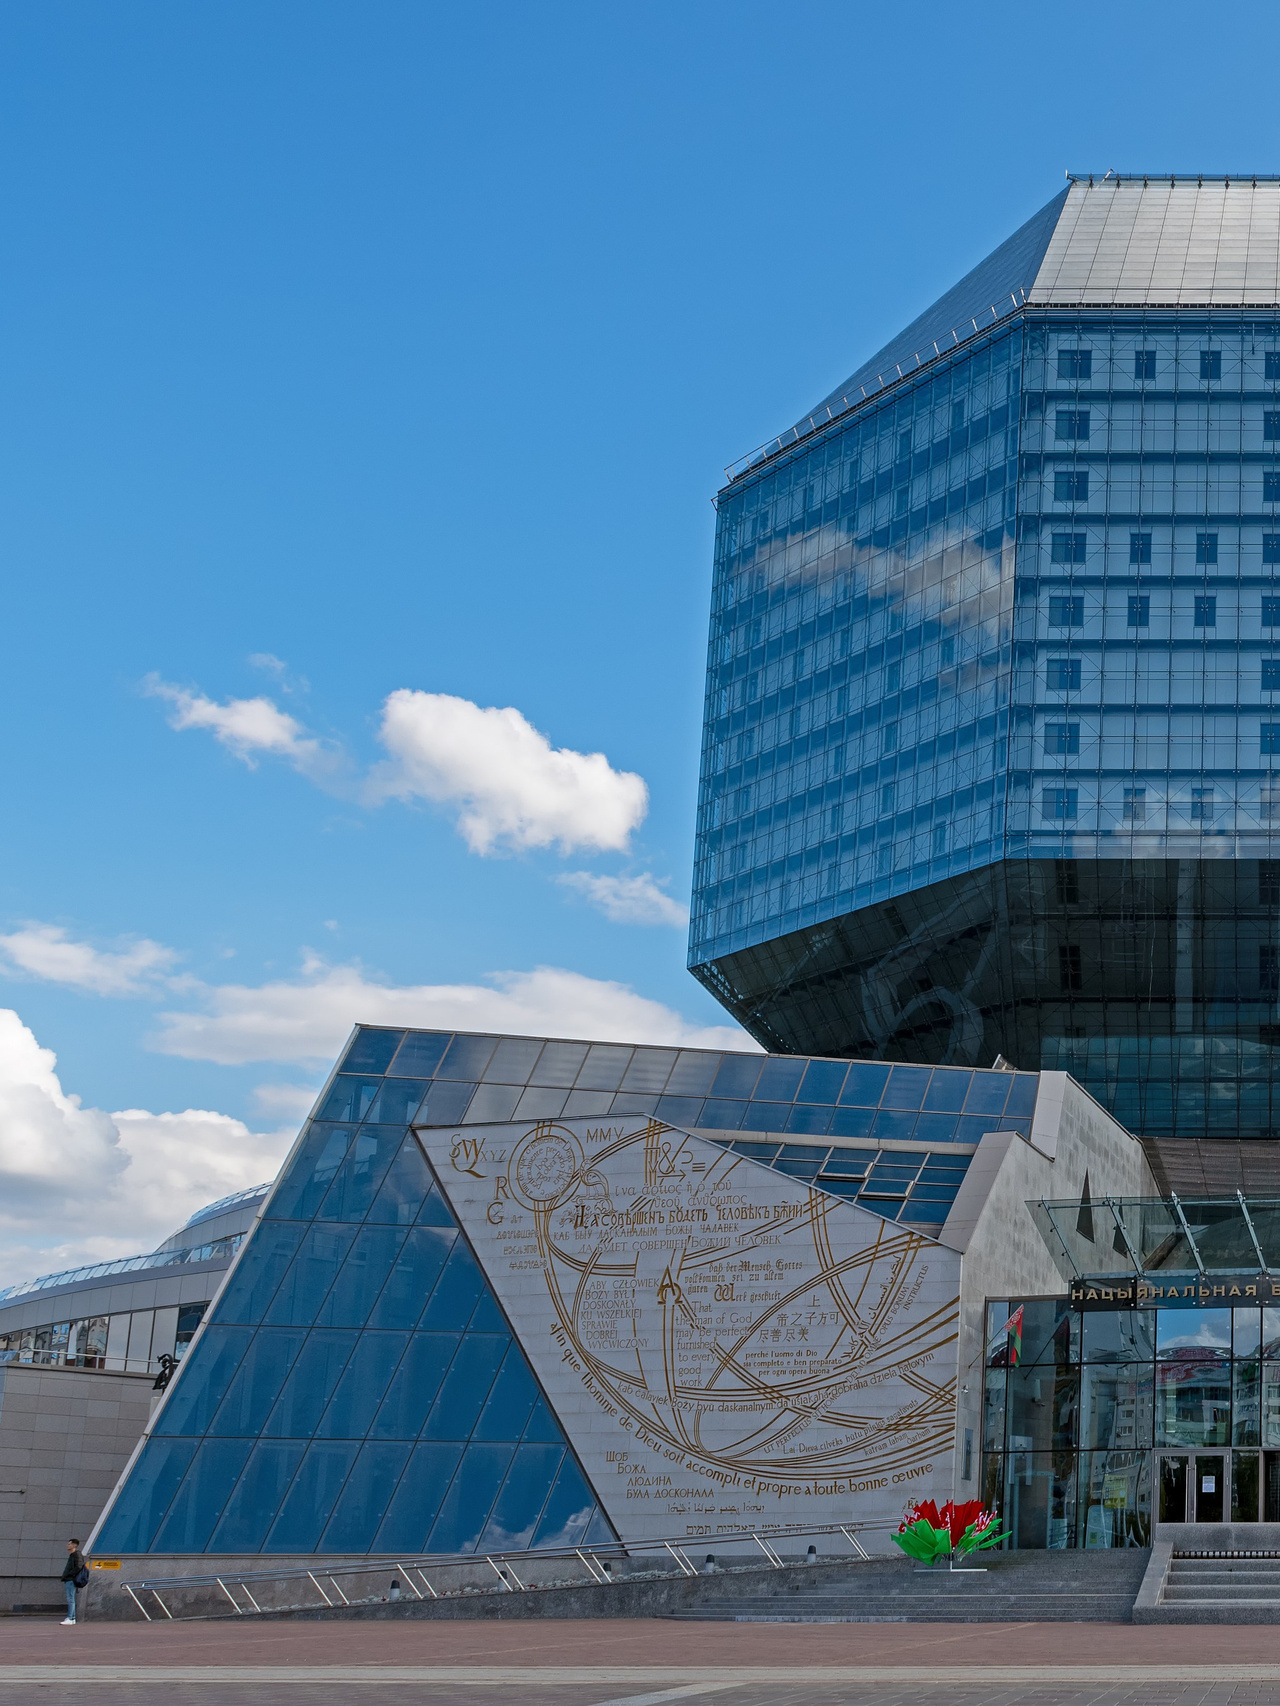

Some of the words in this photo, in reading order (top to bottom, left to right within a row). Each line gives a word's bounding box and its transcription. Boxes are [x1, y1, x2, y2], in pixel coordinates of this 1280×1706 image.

[586, 1126, 624, 1143] MMV
[553, 1231, 570, 1241] КАБ
[665, 1224, 693, 1236] БОЖЫ
[700, 1222, 739, 1233] ЧАЛАВЕК
[632, 1239, 686, 1251] СОВЕРШЕН
[735, 1234, 781, 1246] ЧЕЛОВЕК
[590, 1280, 607, 1290] ABY
[903, 1265, 929, 1311] INSTRUCTUS
[1071, 1283, 1258, 1300] НАЦЫЯНАЛЬНАЯ
[692, 1301, 713, 1313] That
[807, 1294, 821, 1308] 上
[890, 1286, 910, 1315] BONUM
[581, 1311, 593, 1320] KU
[596, 1309, 642, 1320] WSZELKIEJ
[675, 1315, 691, 1326] the
[695, 1316, 713, 1325] man
[716, 1313, 726, 1324] of
[730, 1312, 753, 1324] God
[582, 1320, 618, 1330] SPRAWIE
[675, 1329, 695, 1339] may
[699, 1326, 712, 1337] be
[715, 1325, 749, 1340] perfect
[677, 1337, 717, 1350] furnished
[678, 1353, 688, 1362] to
[691, 1353, 717, 1363] every
[796, 1349, 803, 1357] di
[806, 1349, 817, 1357] Dio
[753, 1359, 784, 1368] completo
[793, 1358, 807, 1366] ben
[809, 1358, 842, 1368] preparato
[678, 1363, 702, 1378] good
[758, 1369, 770, 1377] per
[772, 1368, 787, 1377] ogni
[789, 1368, 807, 1377] opera
[809, 1367, 830, 1375] buona
[680, 1375, 703, 1387] work
[616, 1381, 633, 1395] kab
[550, 1322, 567, 1347] afin
[562, 1348, 581, 1372] que
[619, 1415, 634, 1431] de
[634, 1425, 662, 1453] Dieu
[663, 1448, 686, 1465] soit
[686, 1460, 741, 1488] accompli
[743, 1477, 756, 1490] et
[756, 1481, 802, 1499] propre
[814, 1481, 846, 1496] toute
[849, 1478, 888, 1493] bonne
[617, 1463, 646, 1474] БОЖА
[627, 1476, 672, 1486] ЛЮДИНА
[626, 1488, 650, 1499] БУЛА
[653, 1488, 715, 1499] ДОСКОНАЛА
